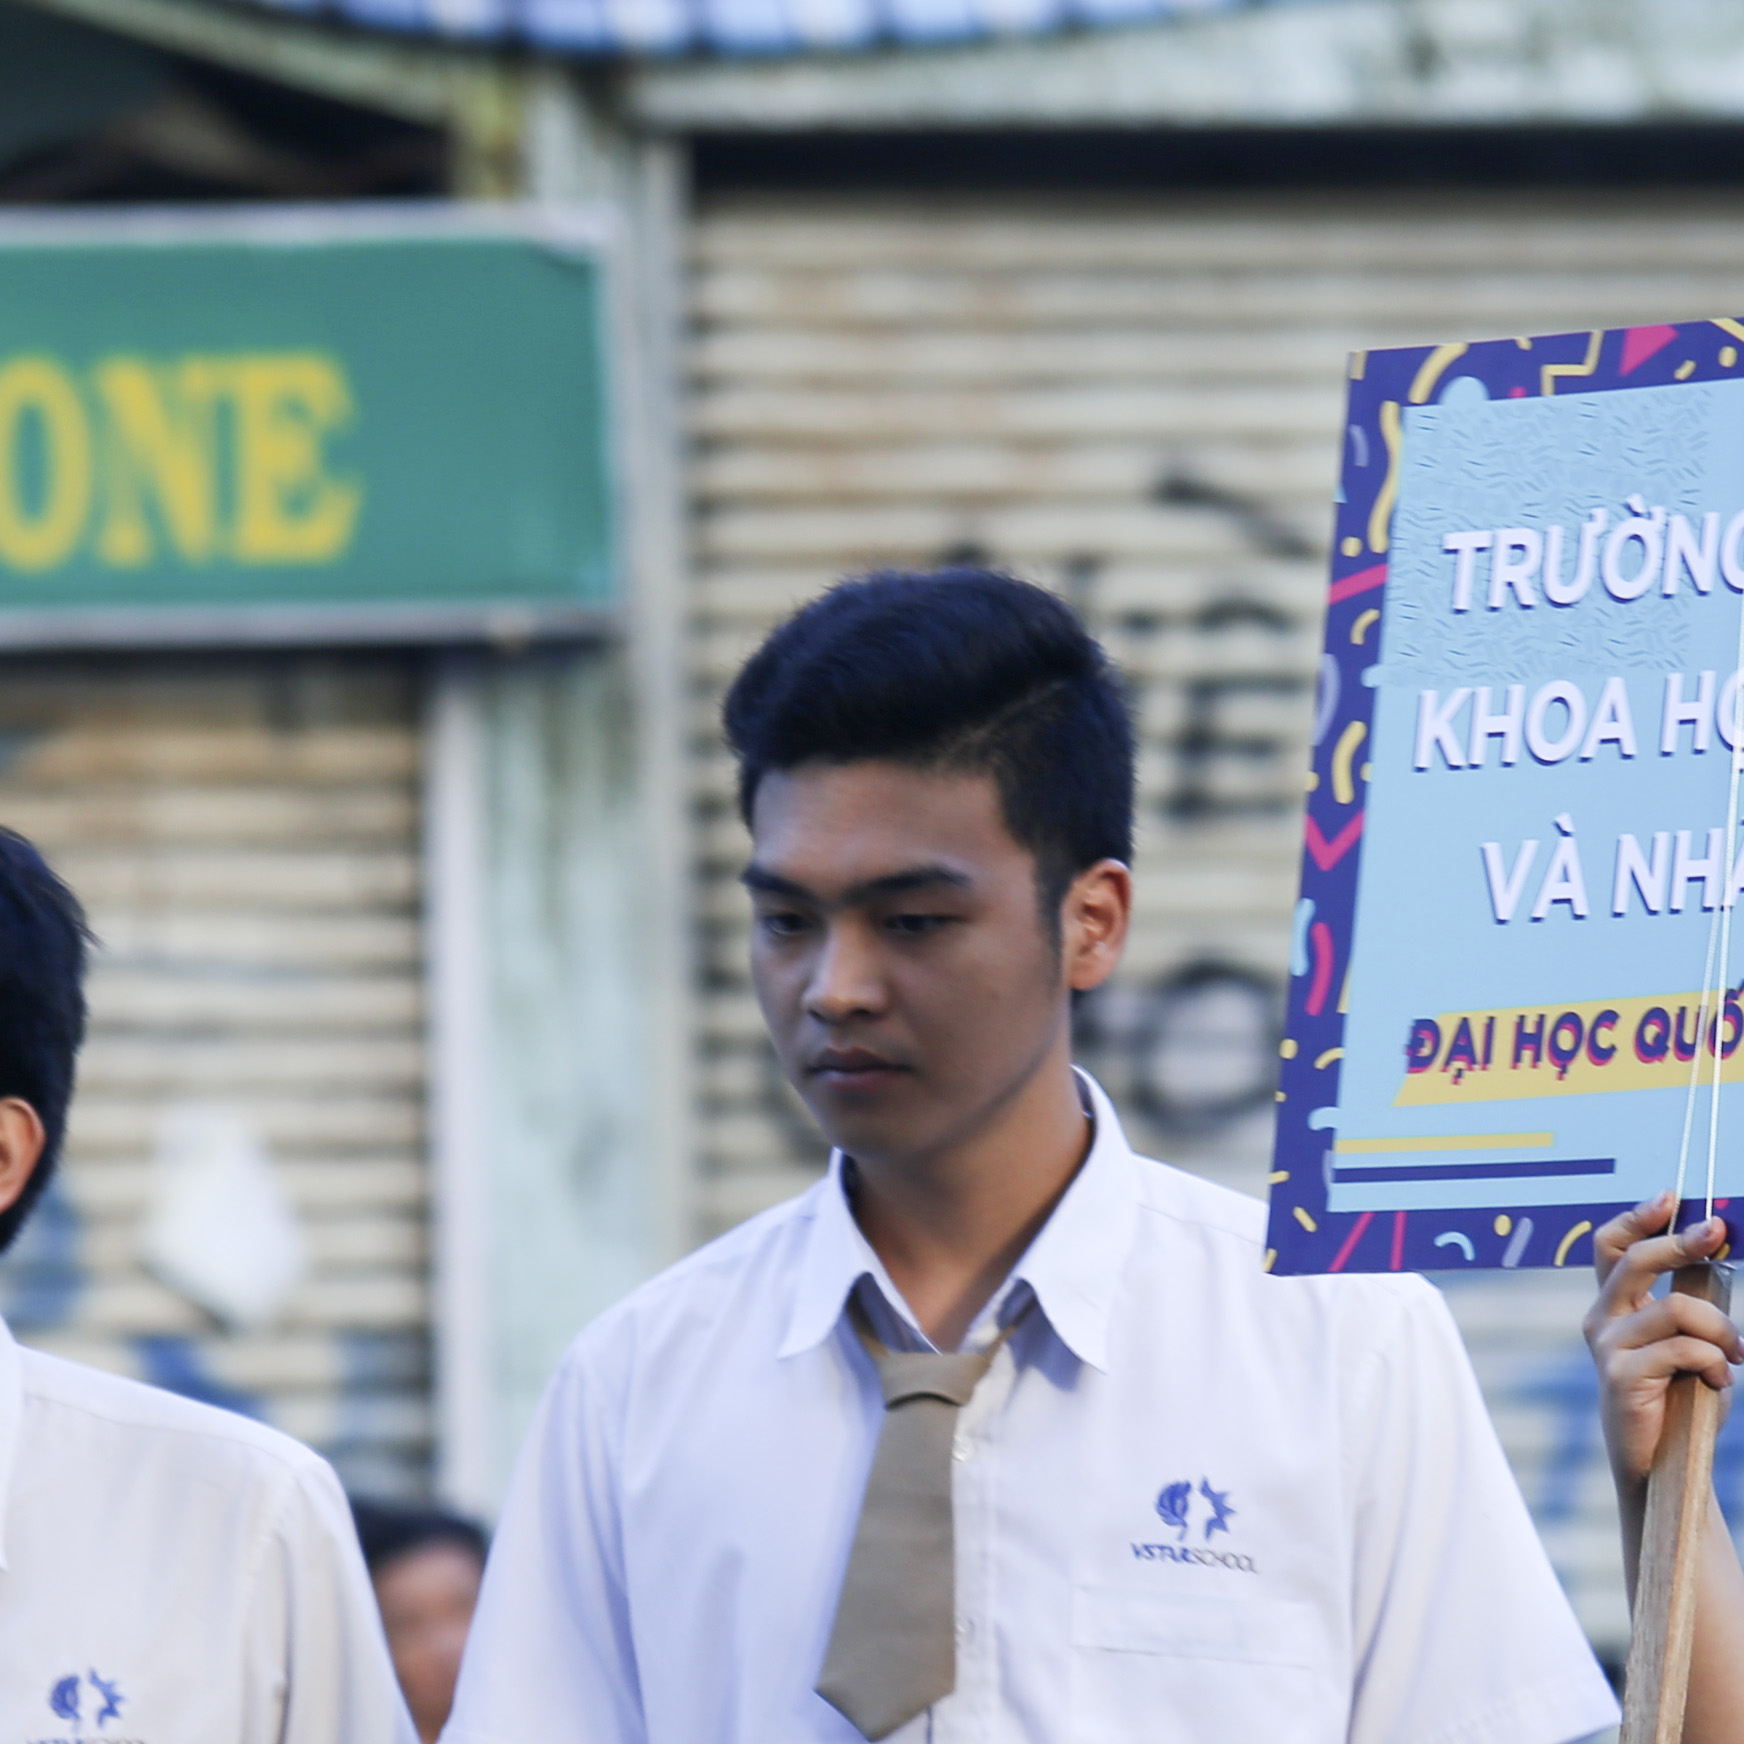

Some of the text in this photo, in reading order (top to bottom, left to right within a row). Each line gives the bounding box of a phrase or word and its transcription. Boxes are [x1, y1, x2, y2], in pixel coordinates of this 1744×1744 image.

[1412, 676, 1638, 772] KHOA
[1480, 812, 1590, 925] VÀ
[1404, 1016, 1495, 1085] ĐẠI
[1510, 1009, 1621, 1080] HỌC
